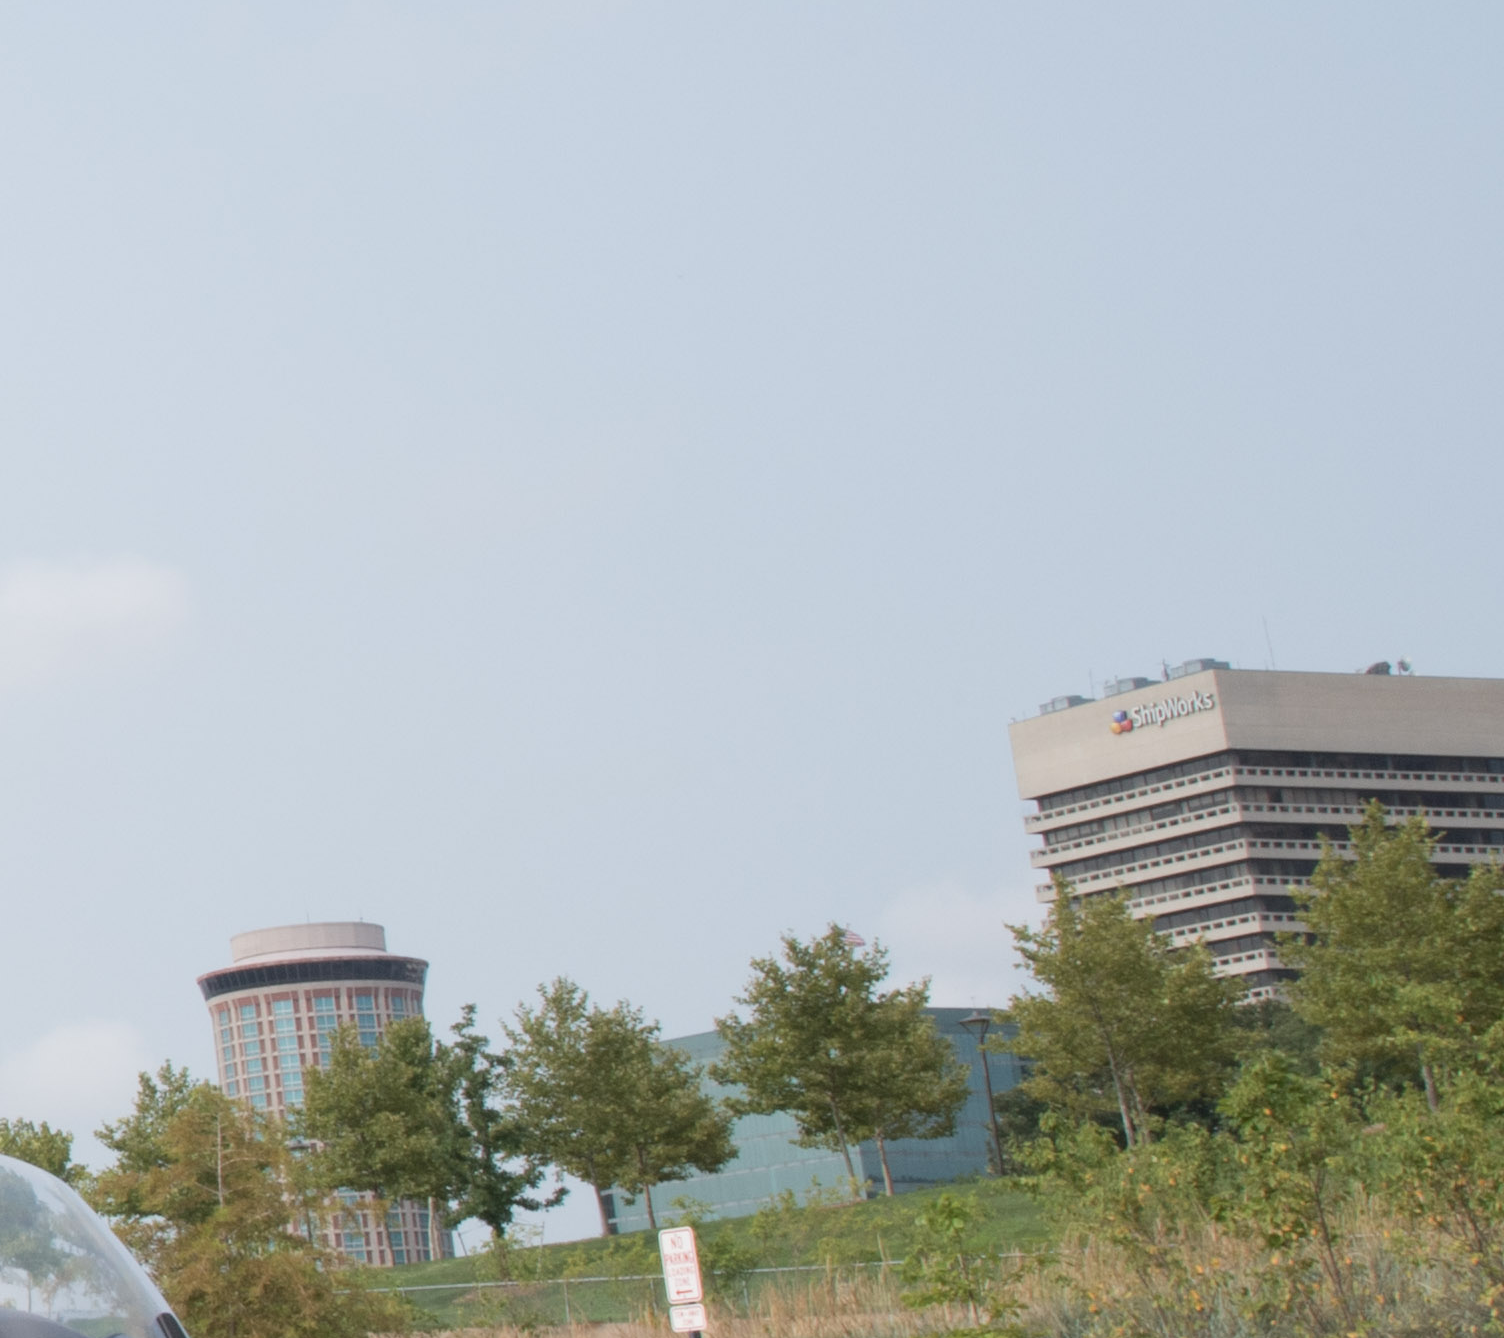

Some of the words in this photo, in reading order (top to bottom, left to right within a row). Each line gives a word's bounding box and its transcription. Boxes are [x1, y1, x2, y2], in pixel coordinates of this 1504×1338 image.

[1130, 690, 1215, 728] ShipWorks
[670, 1236, 683, 1249] NO
[663, 1251, 694, 1265] PARKING
